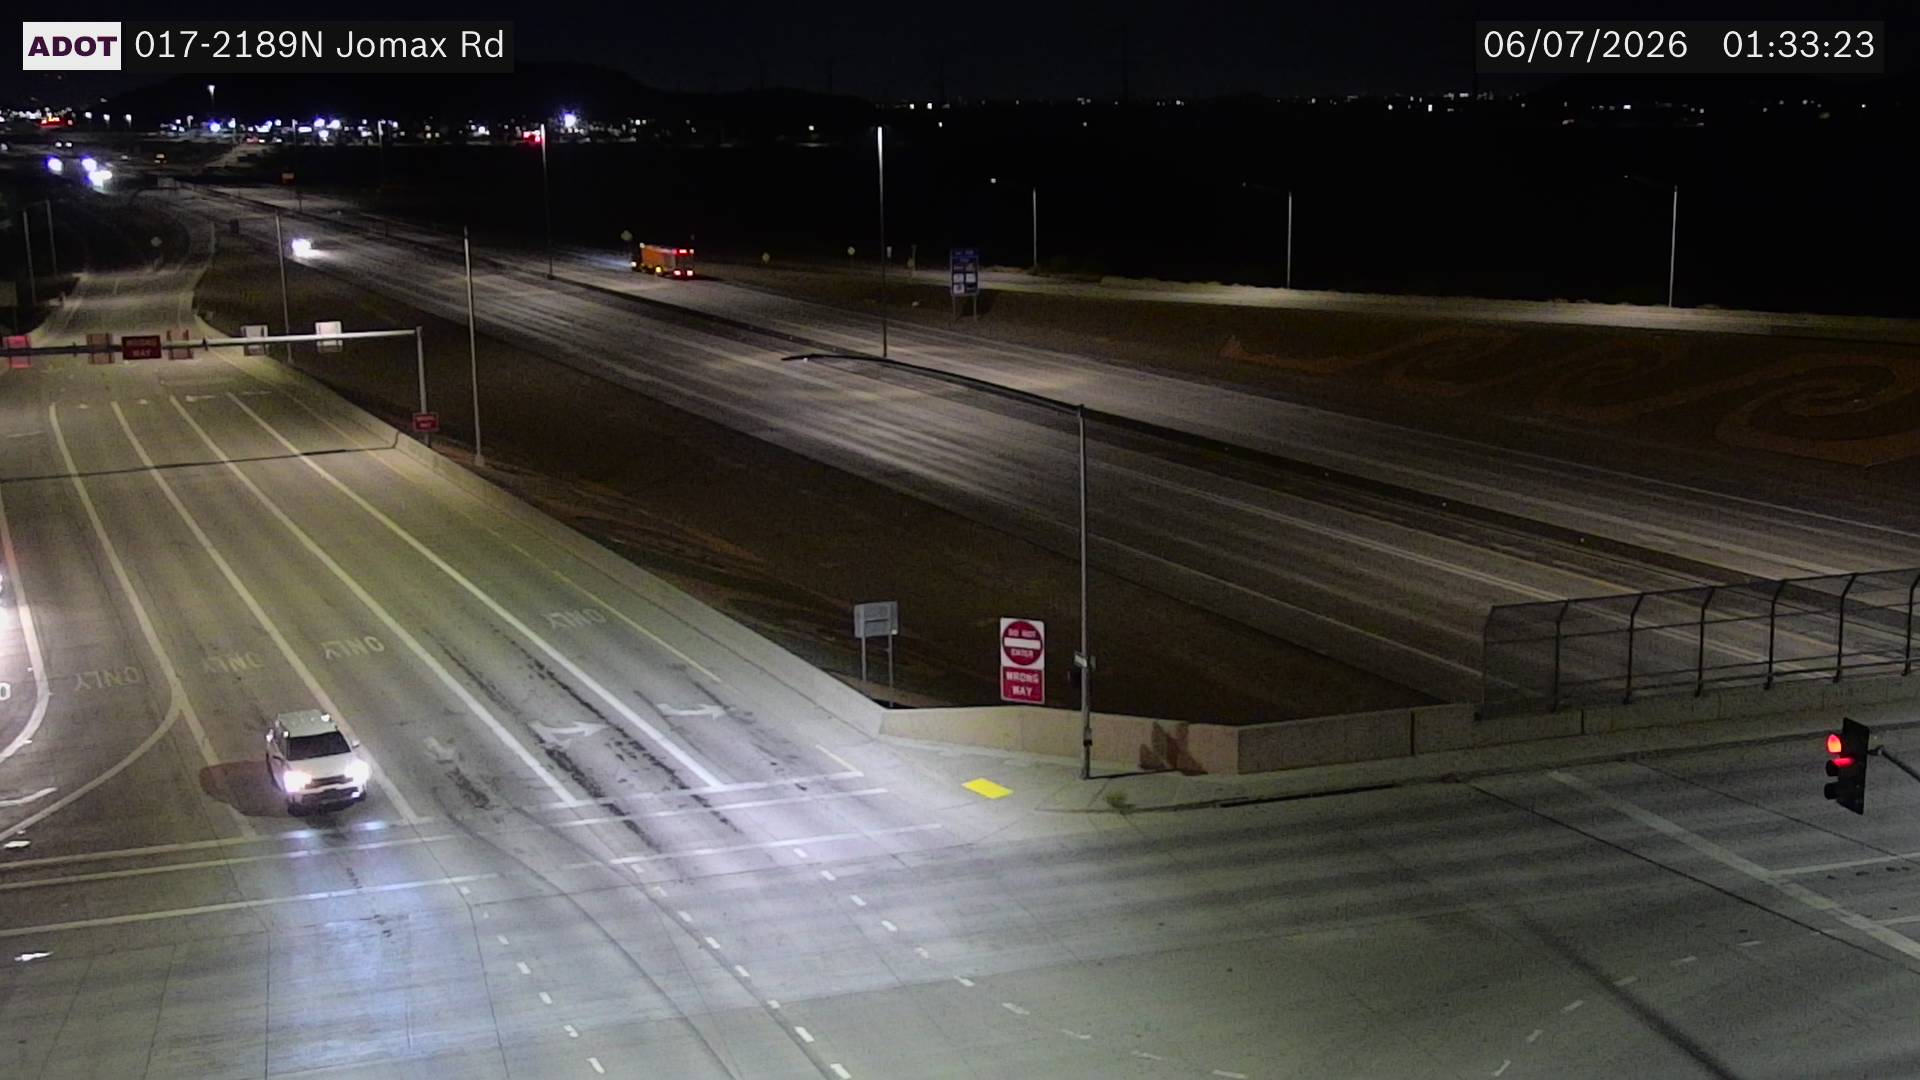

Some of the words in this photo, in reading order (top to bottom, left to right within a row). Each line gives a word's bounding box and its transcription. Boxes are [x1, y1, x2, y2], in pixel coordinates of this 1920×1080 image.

[1008, 628, 1019, 637] DO
[1022, 630, 1037, 638] NOT
[320, 635, 385, 659] ONLY
[1010, 648, 1033, 658] ENTER
[1006, 671, 1039, 684] WRONG
[1012, 685, 1032, 697] WAY
